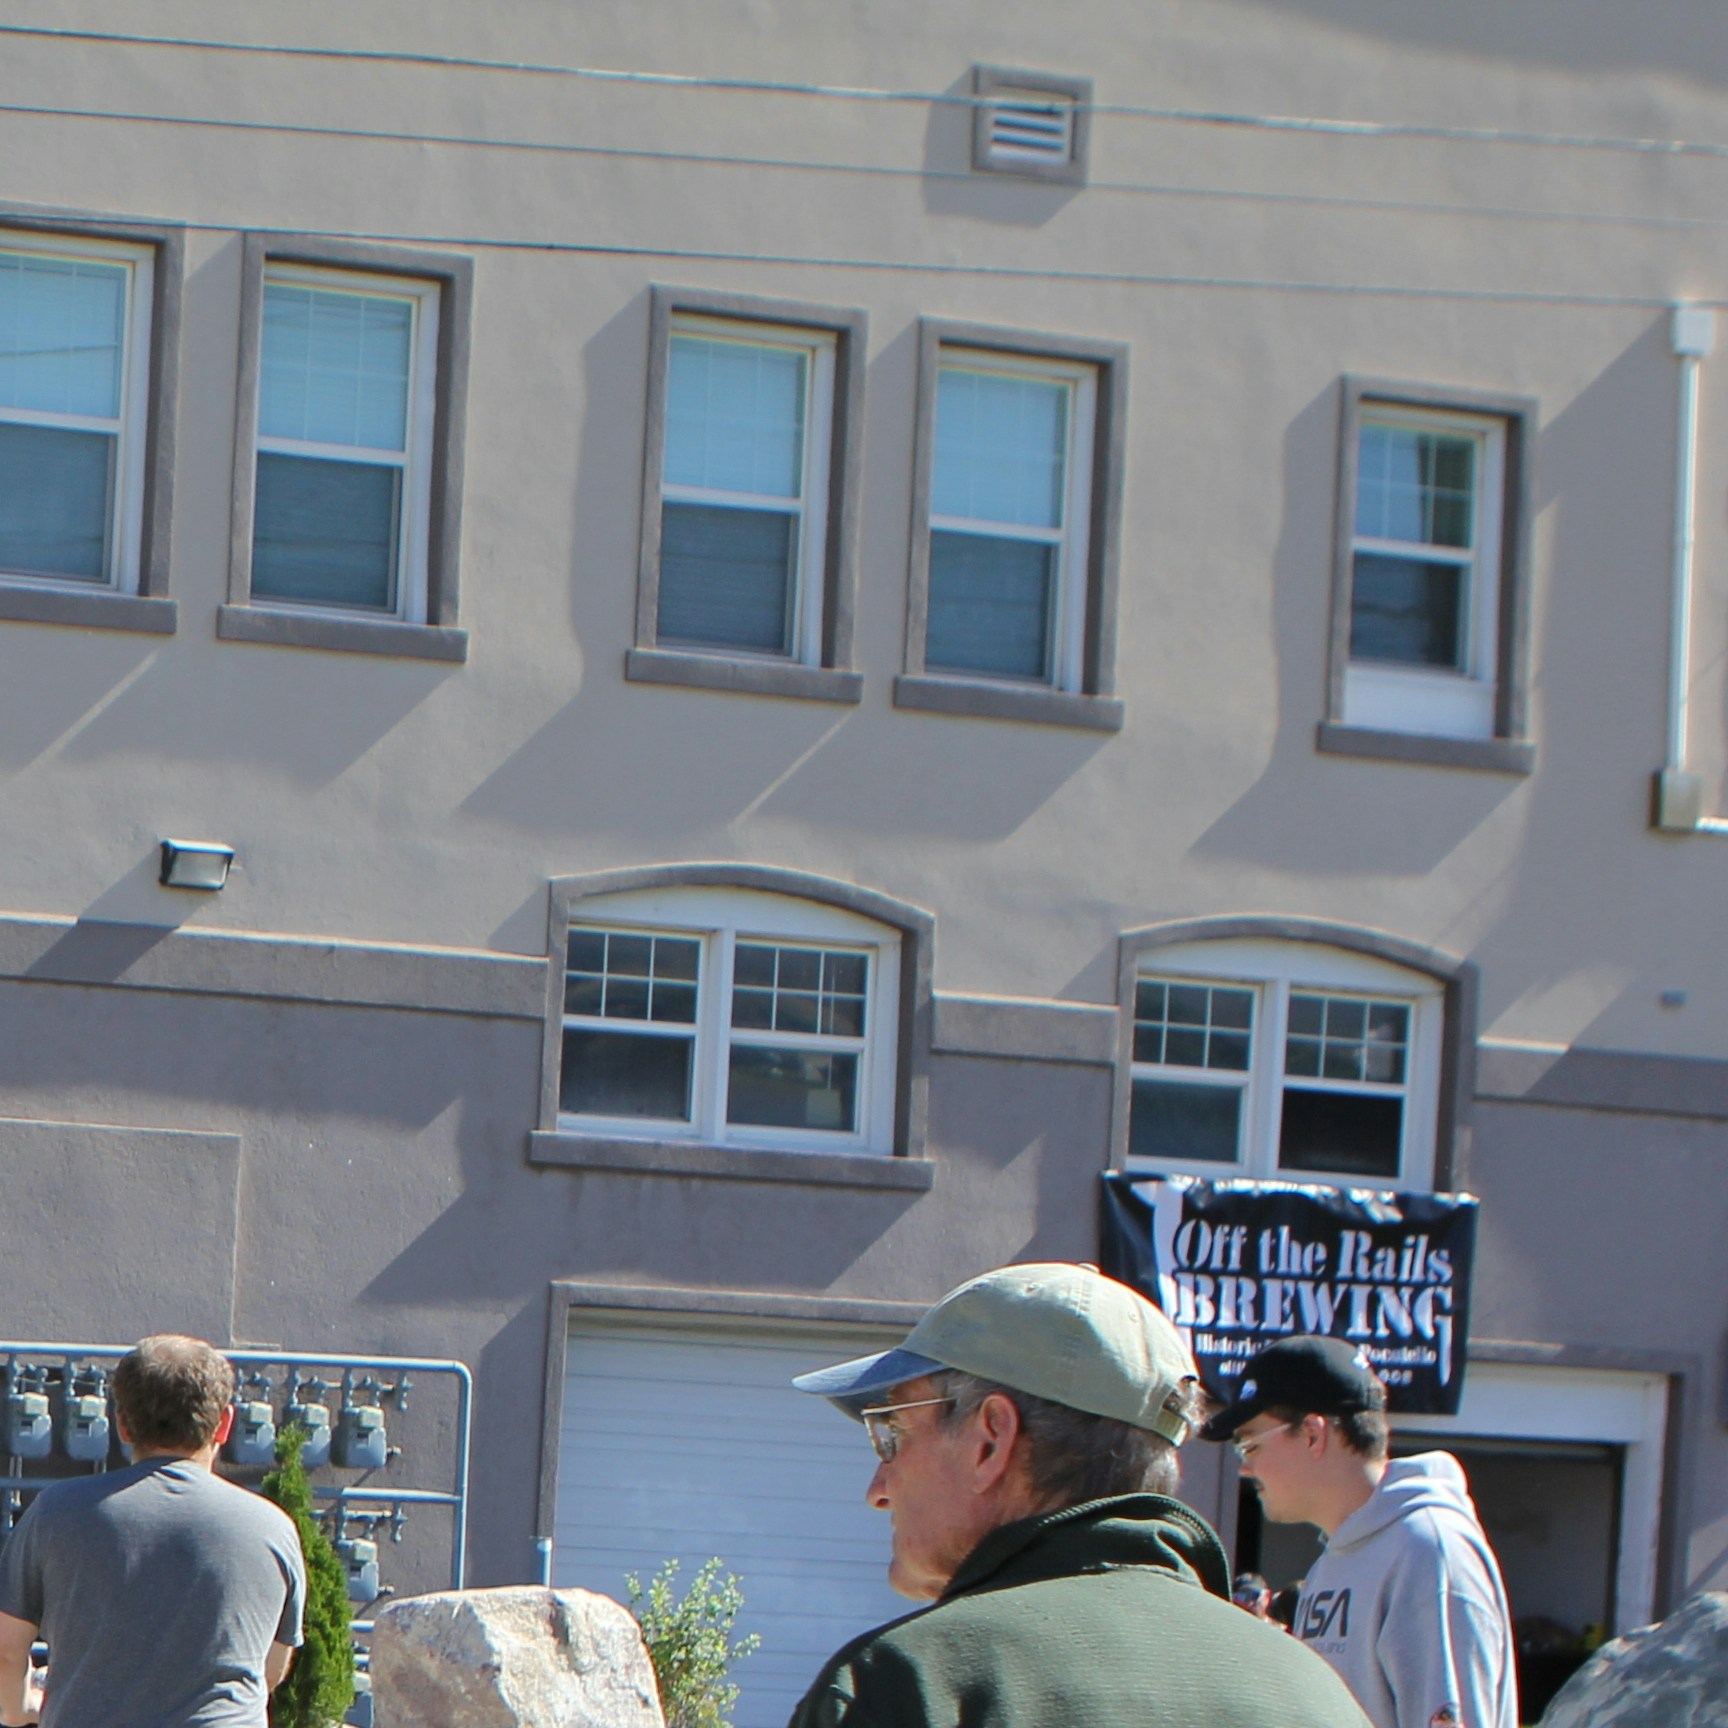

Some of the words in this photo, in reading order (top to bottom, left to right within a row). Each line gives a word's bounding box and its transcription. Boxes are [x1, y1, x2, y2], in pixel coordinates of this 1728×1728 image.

[1175, 1218, 1247, 1271] Off
[1258, 1226, 1327, 1275] the
[1337, 1230, 1454, 1284] Rails
[1176, 1272, 1453, 1340] BREWING
